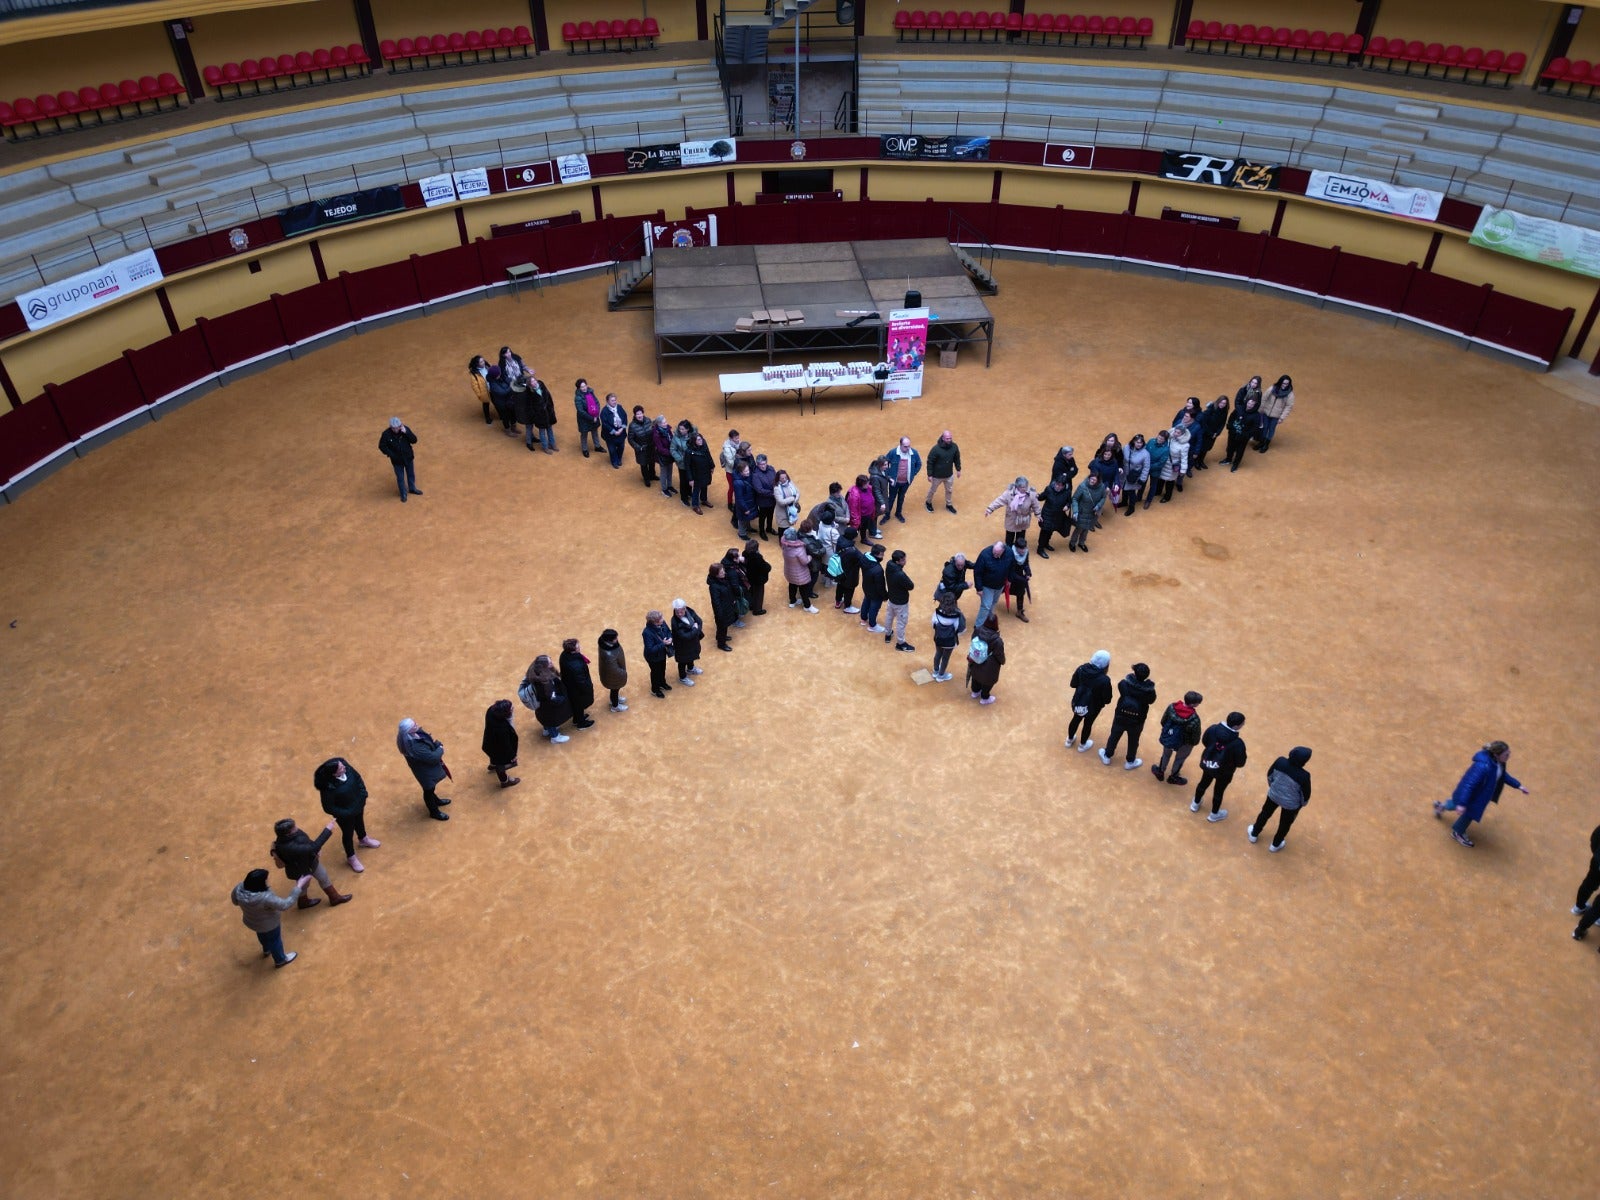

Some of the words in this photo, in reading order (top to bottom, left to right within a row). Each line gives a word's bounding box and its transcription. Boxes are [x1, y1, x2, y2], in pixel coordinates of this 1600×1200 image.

[899, 138, 917, 151] MP
[560, 164, 588, 175] TEJEMO
[457, 178, 487, 190] TEJEMO
[424, 186, 453, 198] TEJEMO
[1330, 182, 1390, 203] EMJOMA
[324, 204, 358, 217] TEJEDOR
[48, 270, 117, 310] gruponani
[1074, 705, 1088, 715] NIKE
